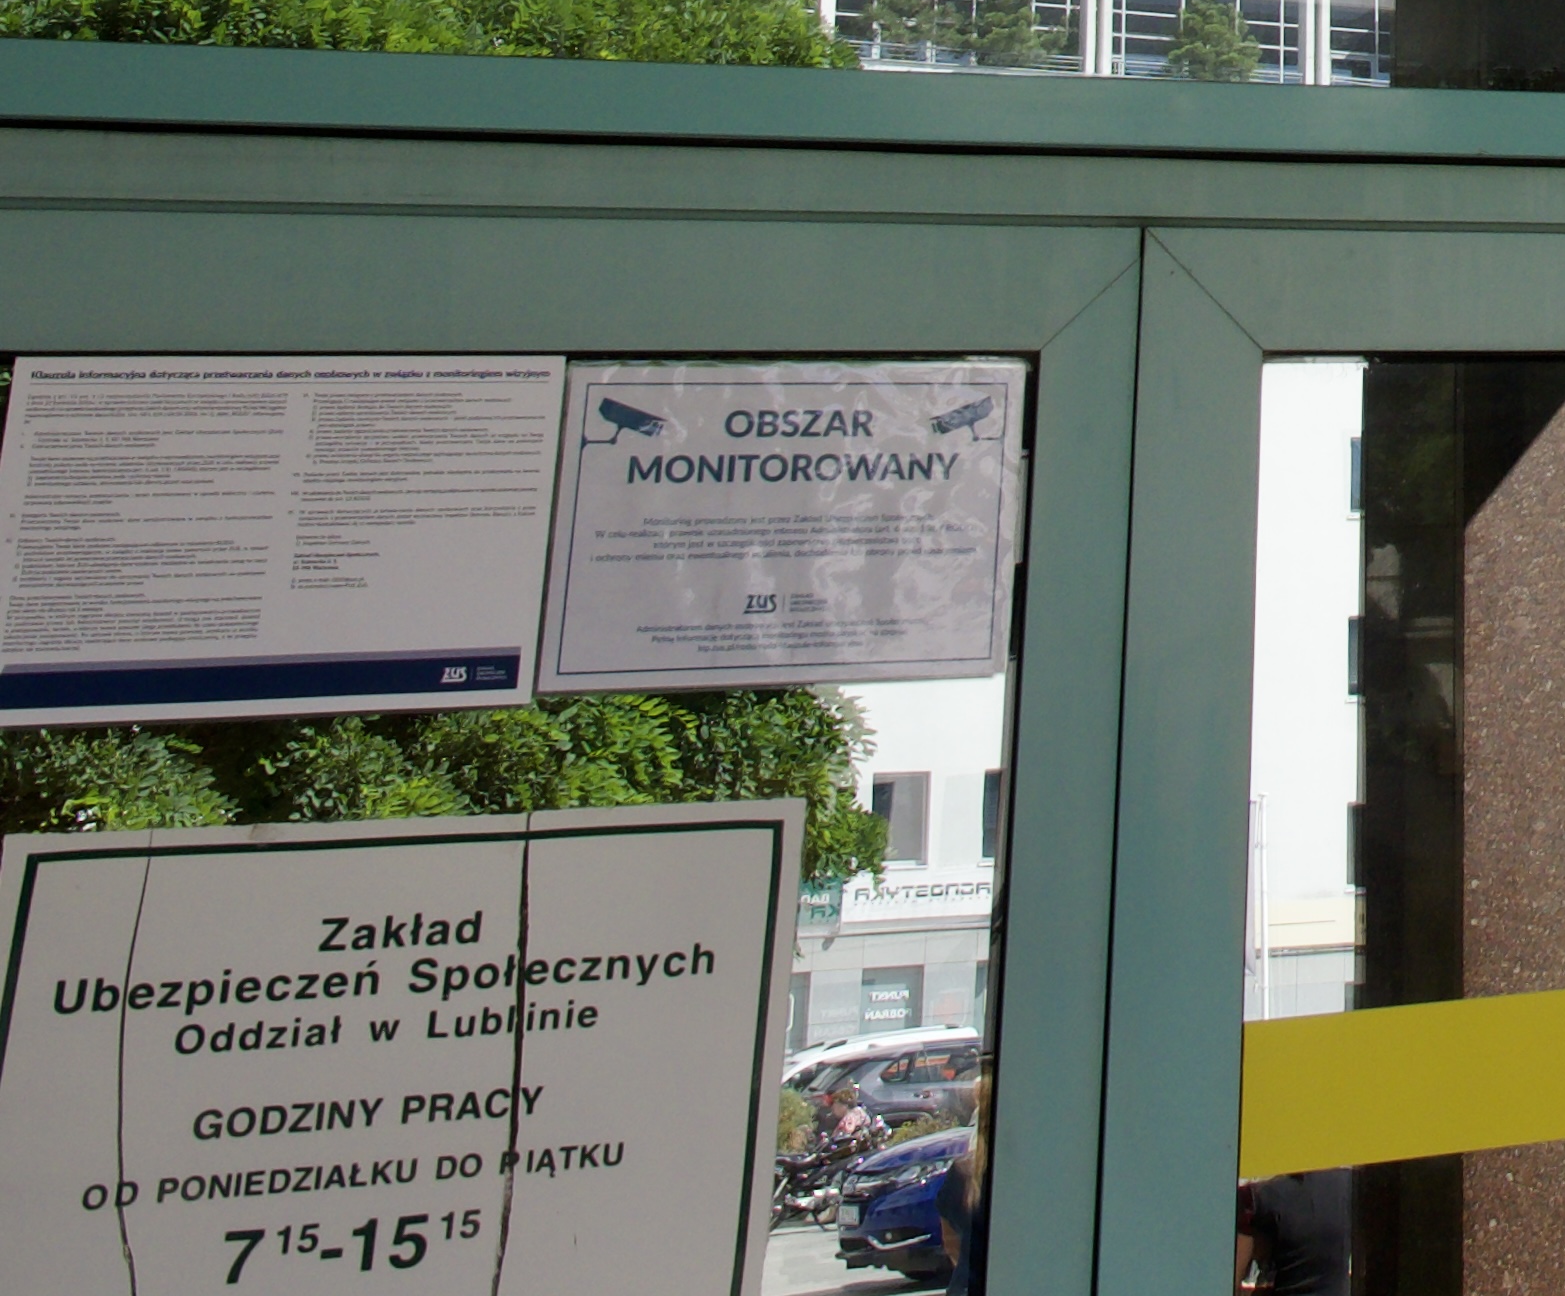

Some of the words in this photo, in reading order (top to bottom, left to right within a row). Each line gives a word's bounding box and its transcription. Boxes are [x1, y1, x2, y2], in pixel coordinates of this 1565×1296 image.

[723, 409, 873, 439] OBSZAR
[625, 452, 959, 485] MONITOROWANY
[743, 593, 778, 615] ZUS
[440, 665, 468, 684] ZUS
[318, 910, 483, 952] Zakład
[53, 960, 381, 1015] Ubezpieczeń
[408, 942, 716, 1001] Społecznych
[174, 1015, 342, 1055] Oddział
[369, 1019, 400, 1042] w
[427, 999, 600, 1039] Lublinie
[192, 1097, 384, 1140] GODZINY
[401, 1085, 545, 1124] PRACY
[81, 1180, 139, 1211] OD
[156, 1158, 418, 1203] PONIEDZIAŁKU
[435, 1153, 483, 1181] DO
[499, 1141, 625, 1178] PIĄTKU
